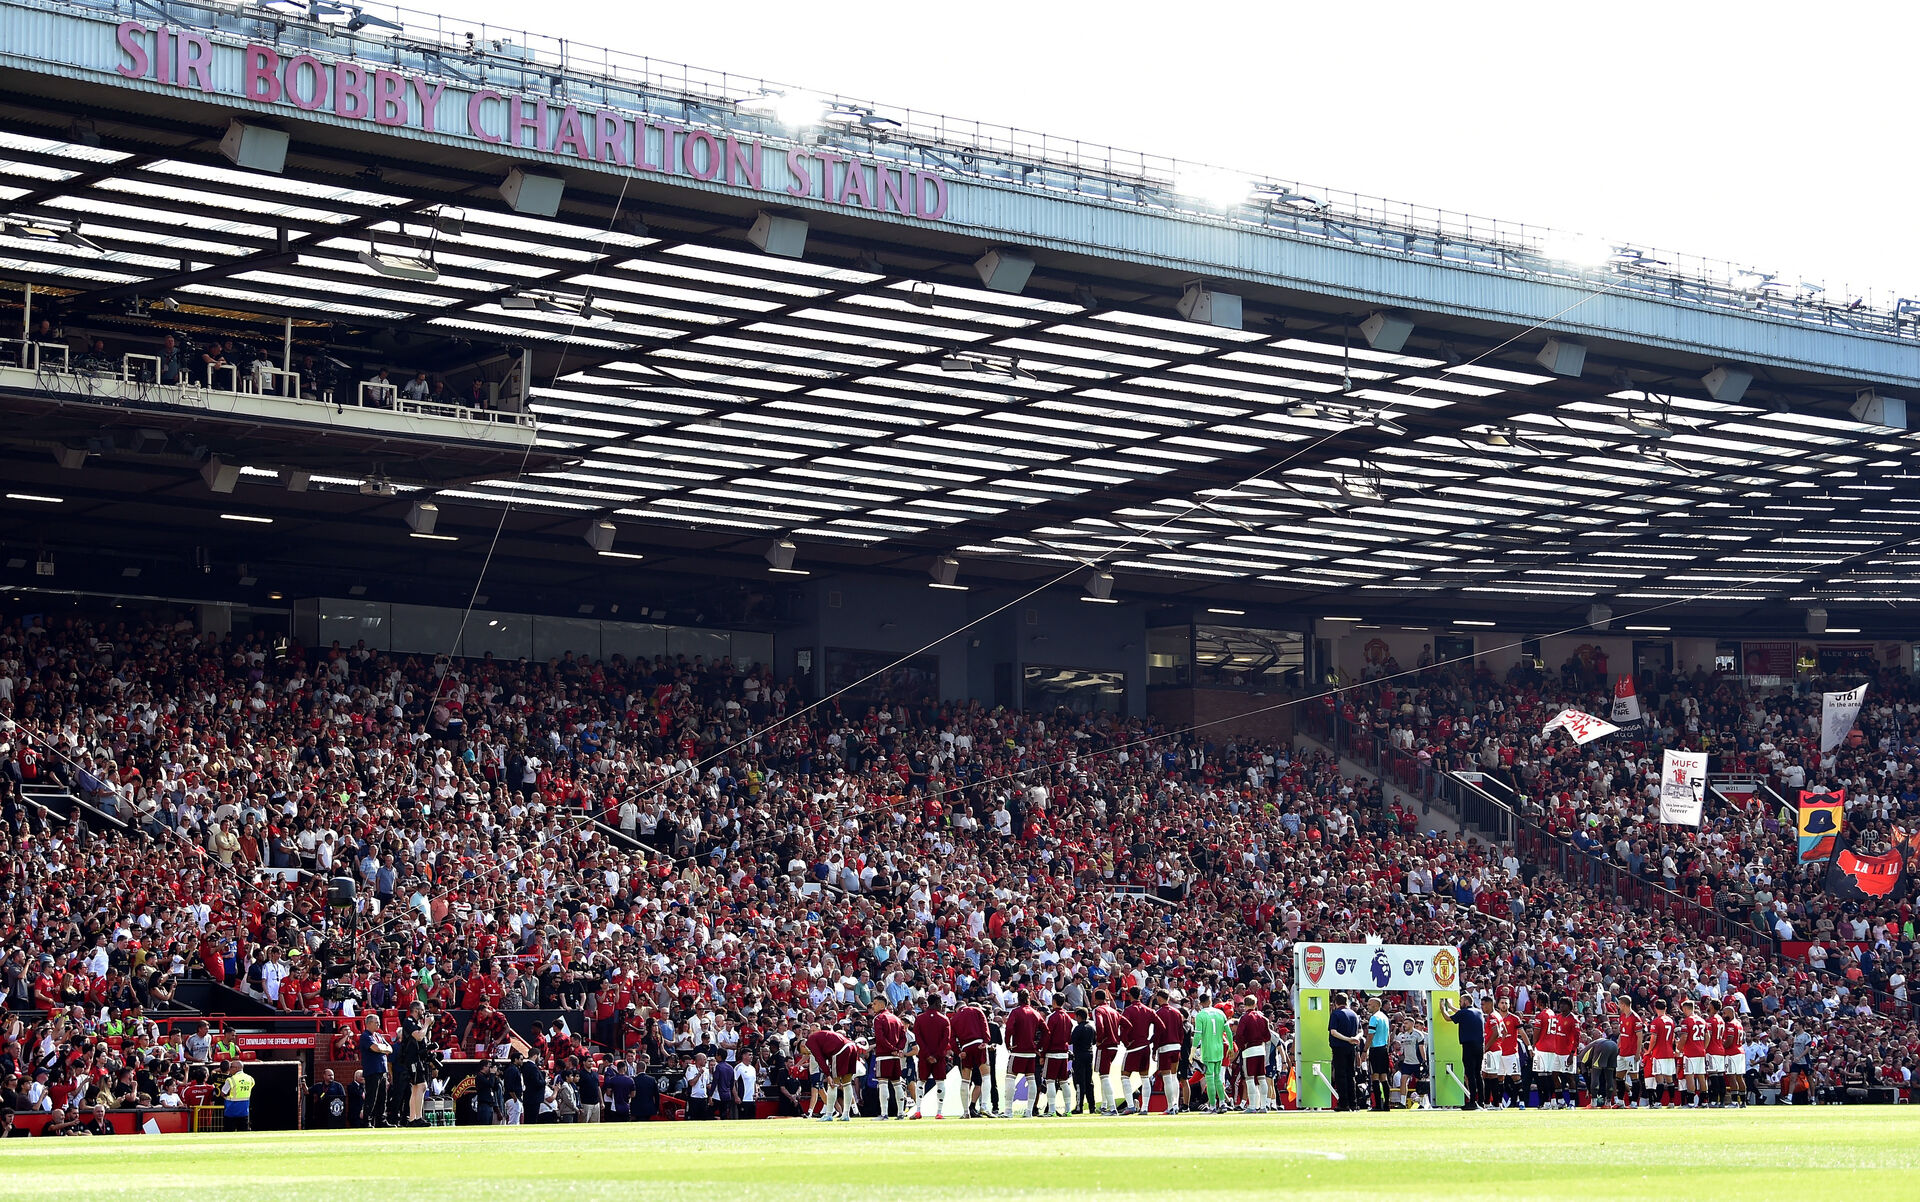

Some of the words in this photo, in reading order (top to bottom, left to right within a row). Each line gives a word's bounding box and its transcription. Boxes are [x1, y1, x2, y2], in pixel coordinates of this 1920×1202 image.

[116, 21, 214, 93] SIR
[246, 44, 446, 133] BOBBY
[468, 89, 762, 192] CHARLTON
[787, 150, 948, 220] STAND
[1671, 760, 1698, 768] MUFC
[1854, 859, 1869, 874] LA
[1872, 863, 1885, 875] LA
[1887, 862, 1899, 875] LA
[1211, 1019, 1216, 1035] 1
[1547, 1018, 1558, 1034] 15
[1664, 1025, 1672, 1040] 7
[1692, 1024, 1705, 1040] 23
[298, 1037, 307, 1045] NOW
